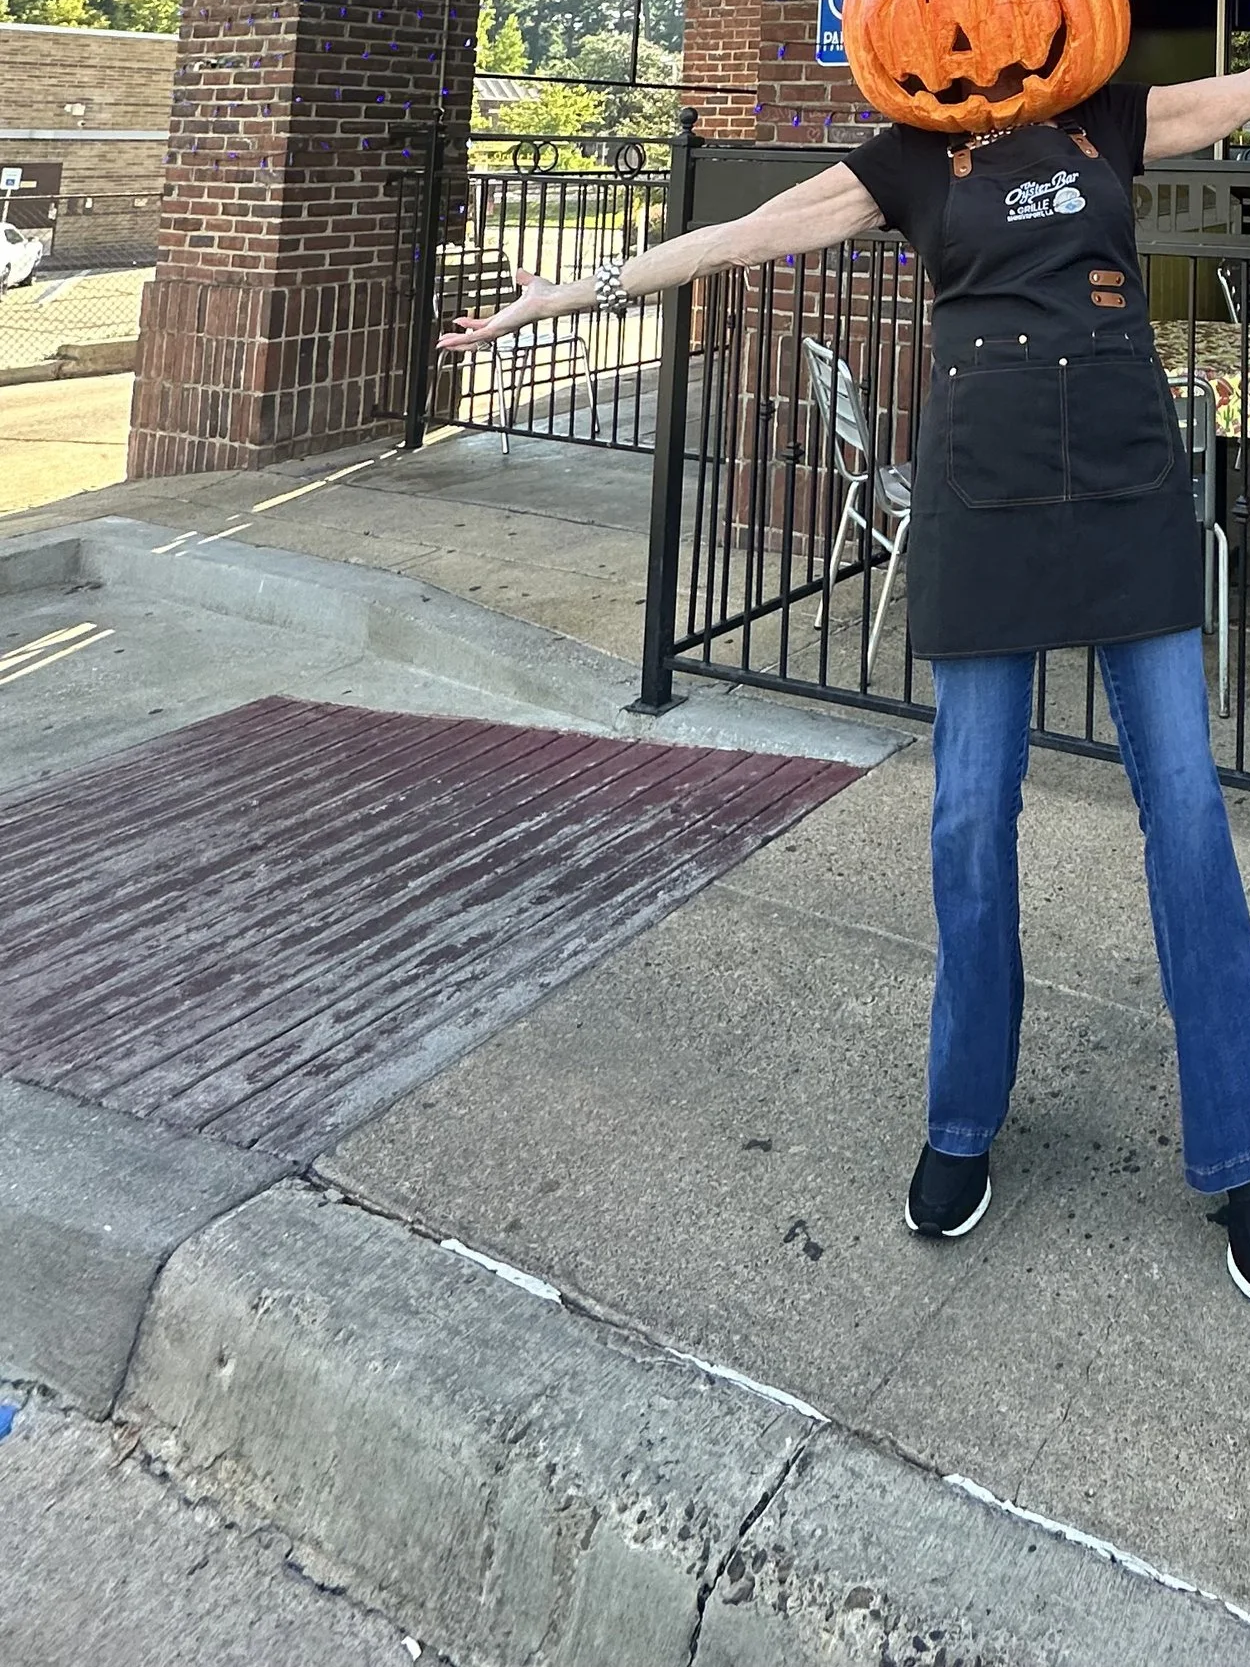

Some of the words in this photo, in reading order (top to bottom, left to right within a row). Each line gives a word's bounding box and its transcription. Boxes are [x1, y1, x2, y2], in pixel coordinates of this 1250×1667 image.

[1005, 183, 1052, 205] Oyster
[1052, 170, 1080, 190] Bar
[1017, 198, 1050, 215] GRILLE
